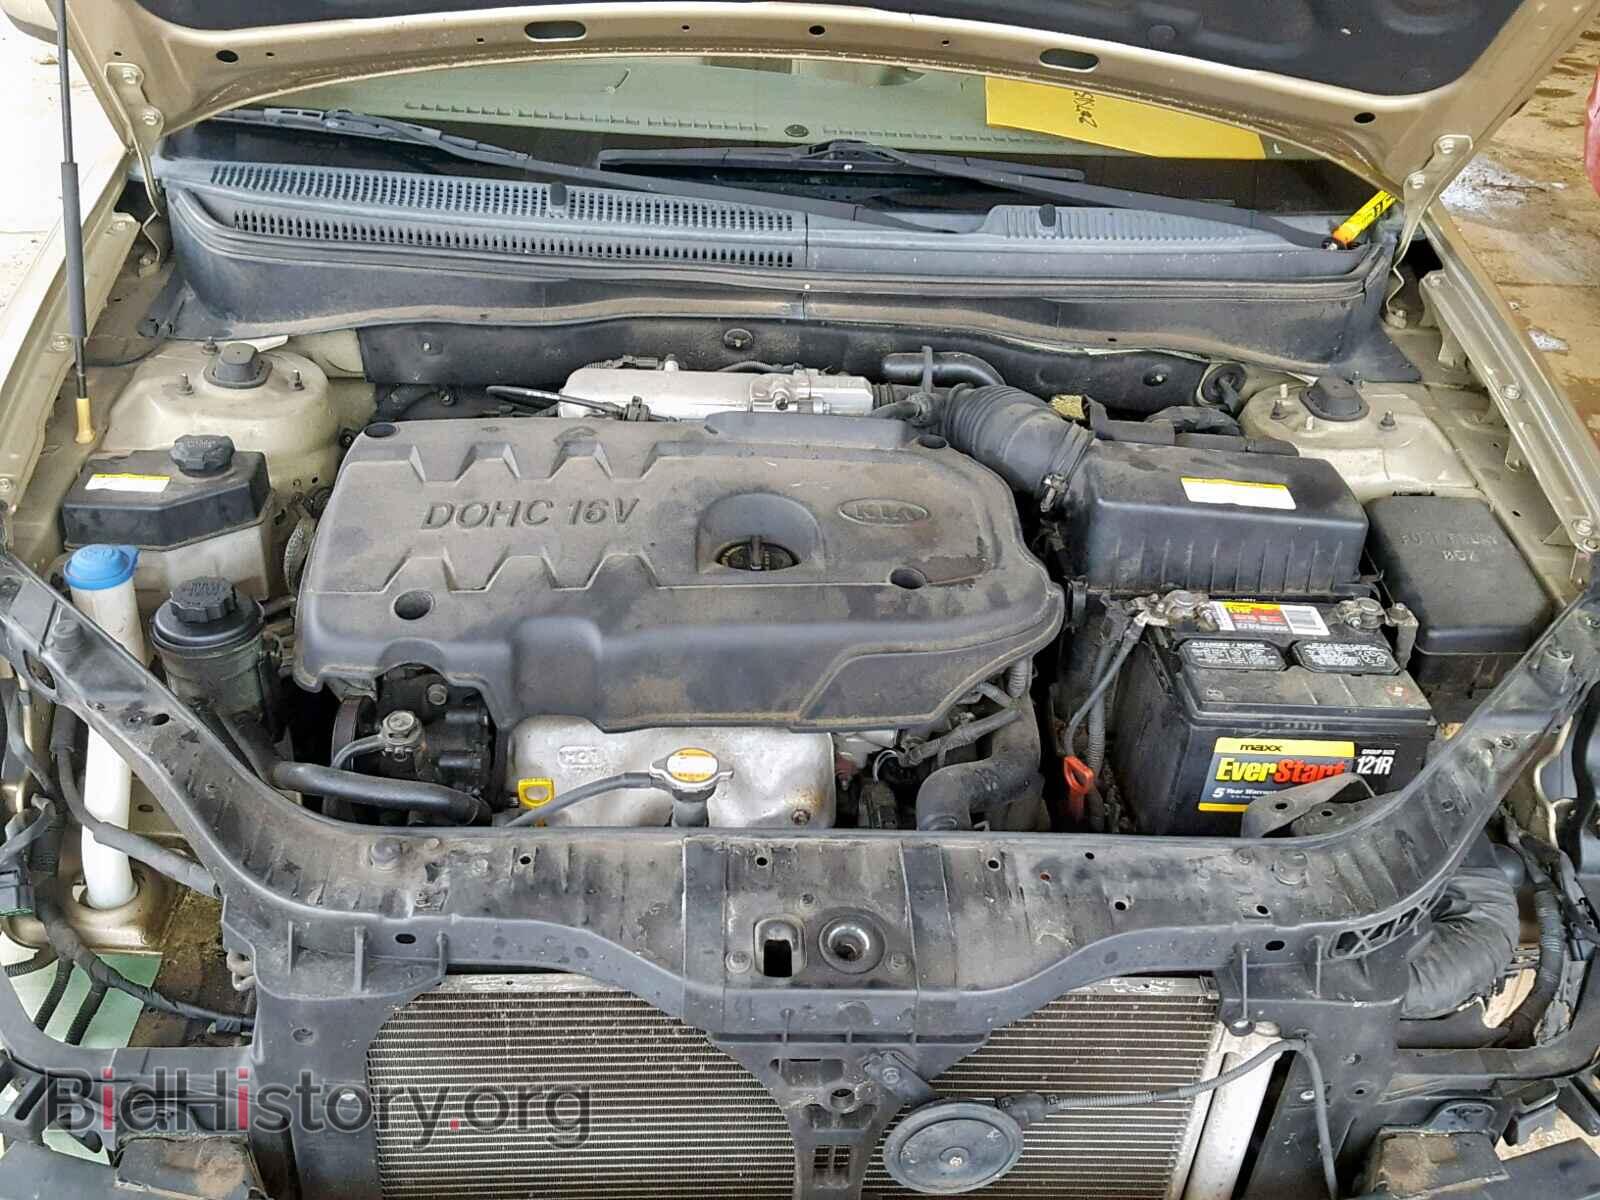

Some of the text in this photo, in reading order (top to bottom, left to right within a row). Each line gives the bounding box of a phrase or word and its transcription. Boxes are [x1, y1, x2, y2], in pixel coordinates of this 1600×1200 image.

[421, 498, 640, 530] DOHC 16V
[1239, 743, 1283, 752] maxx
[1356, 755, 1394, 775] 121R
[1212, 787, 1226, 798] 5
